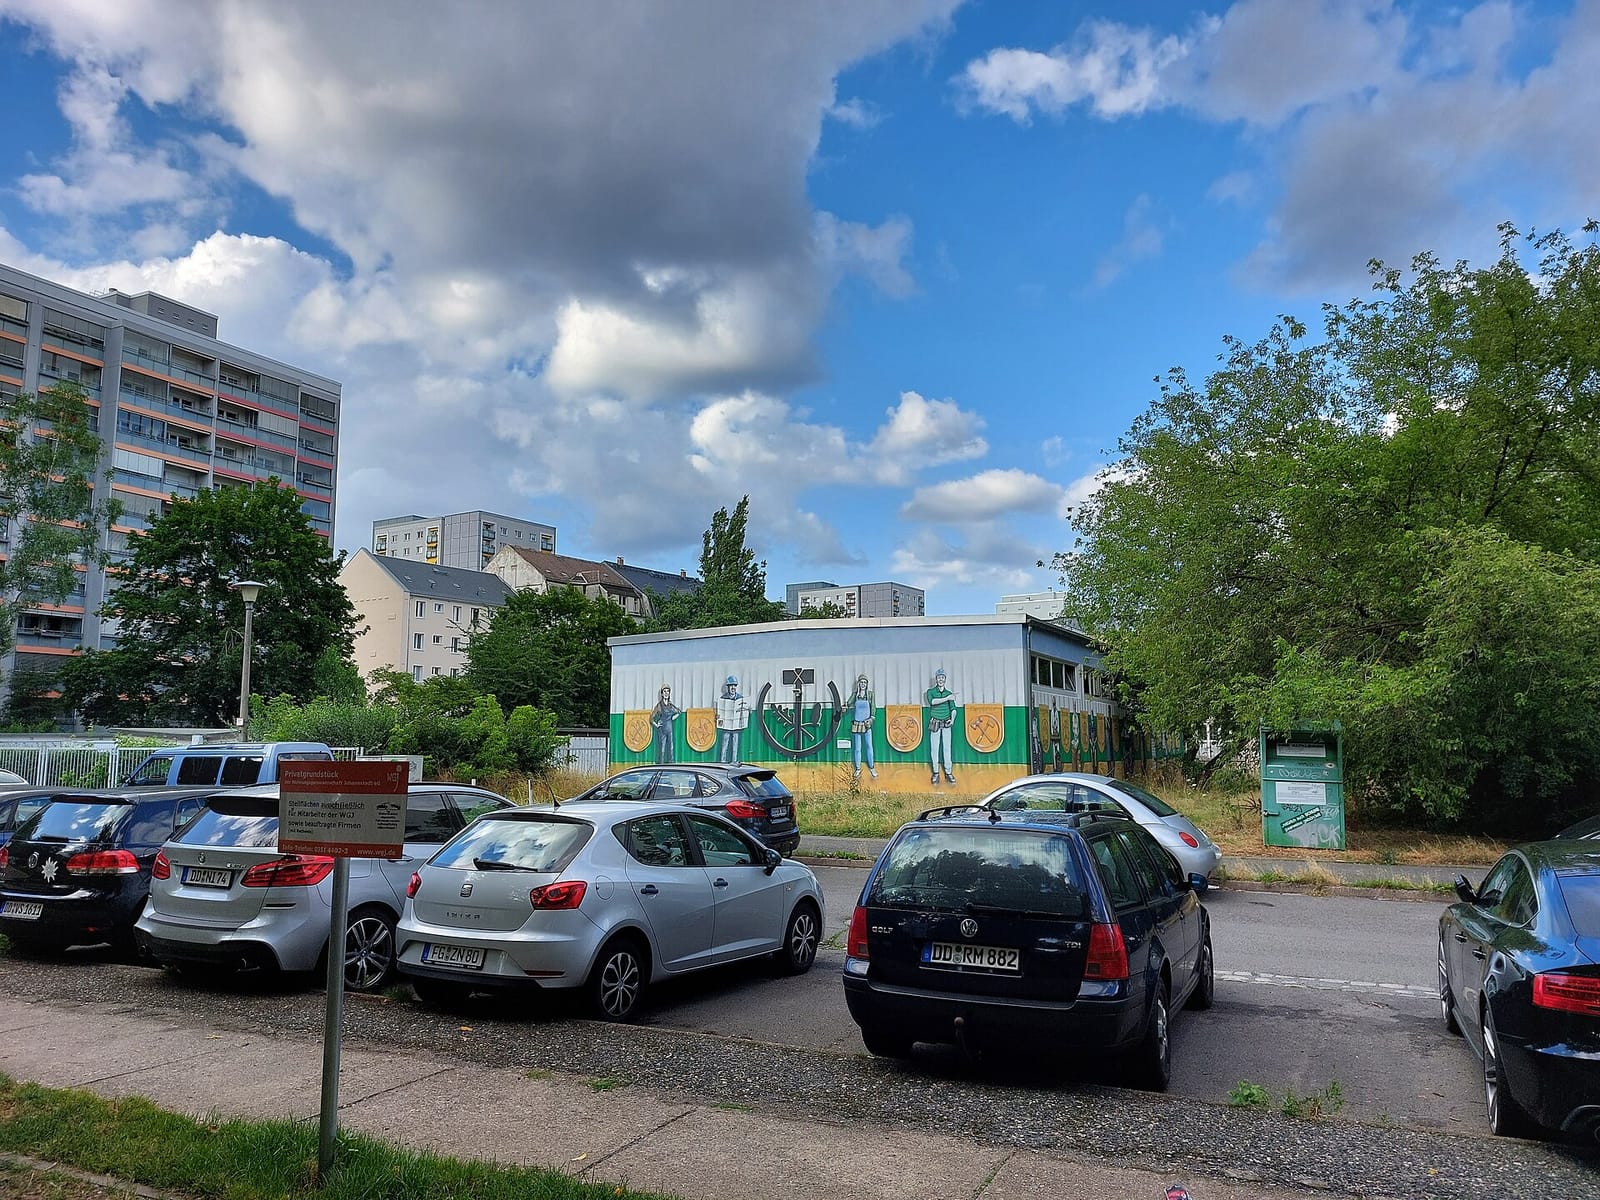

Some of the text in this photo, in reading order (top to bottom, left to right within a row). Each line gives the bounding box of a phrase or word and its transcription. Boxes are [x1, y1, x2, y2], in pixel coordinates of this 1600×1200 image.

[284, 770, 339, 779] Privatgrundstück
[288, 800, 365, 809] Stellflächen ausschließlich
[288, 808, 296, 817] für
[297, 810, 326, 818] Mitarbeiter
[327, 811, 338, 819] der
[288, 820, 304, 828] sowie
[304, 820, 337, 830] beauftragte
[357, 849, 396, 857] www.wgj.de
[871, 925, 894, 934] GOLF
[1064, 940, 1081, 949] TDI
[431, 945, 480, 964] FG ZN 80
[932, 943, 1018, 968] DD RM 882
